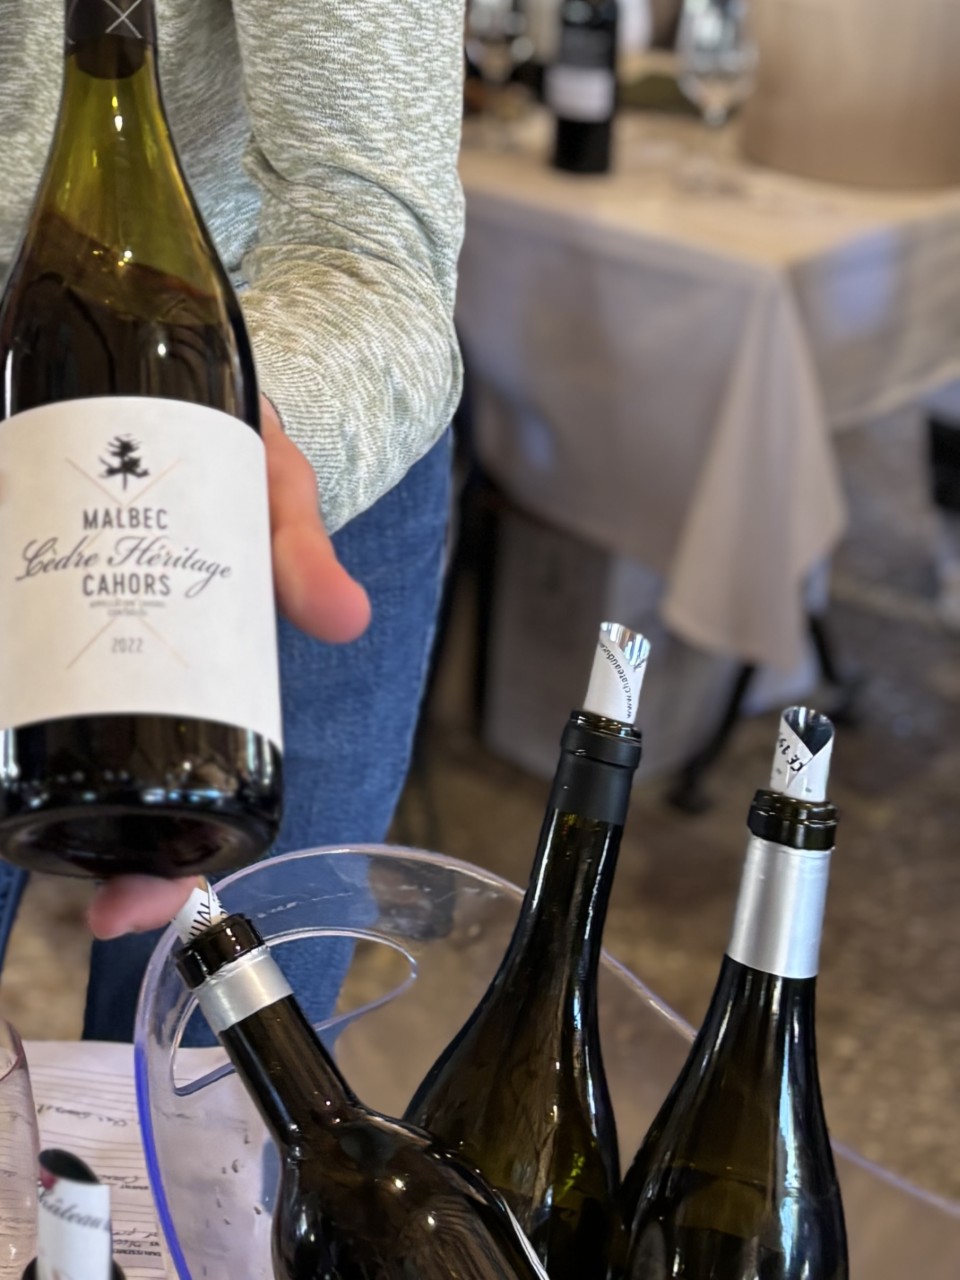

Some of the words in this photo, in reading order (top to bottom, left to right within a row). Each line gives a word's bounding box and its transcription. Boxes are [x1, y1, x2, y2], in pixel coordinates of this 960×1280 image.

[82, 507, 168, 531] MALBEC
[107, 535, 232, 599] Héritage
[81, 573, 172, 598] CAHORS
[110, 636, 144, 655] 2022
